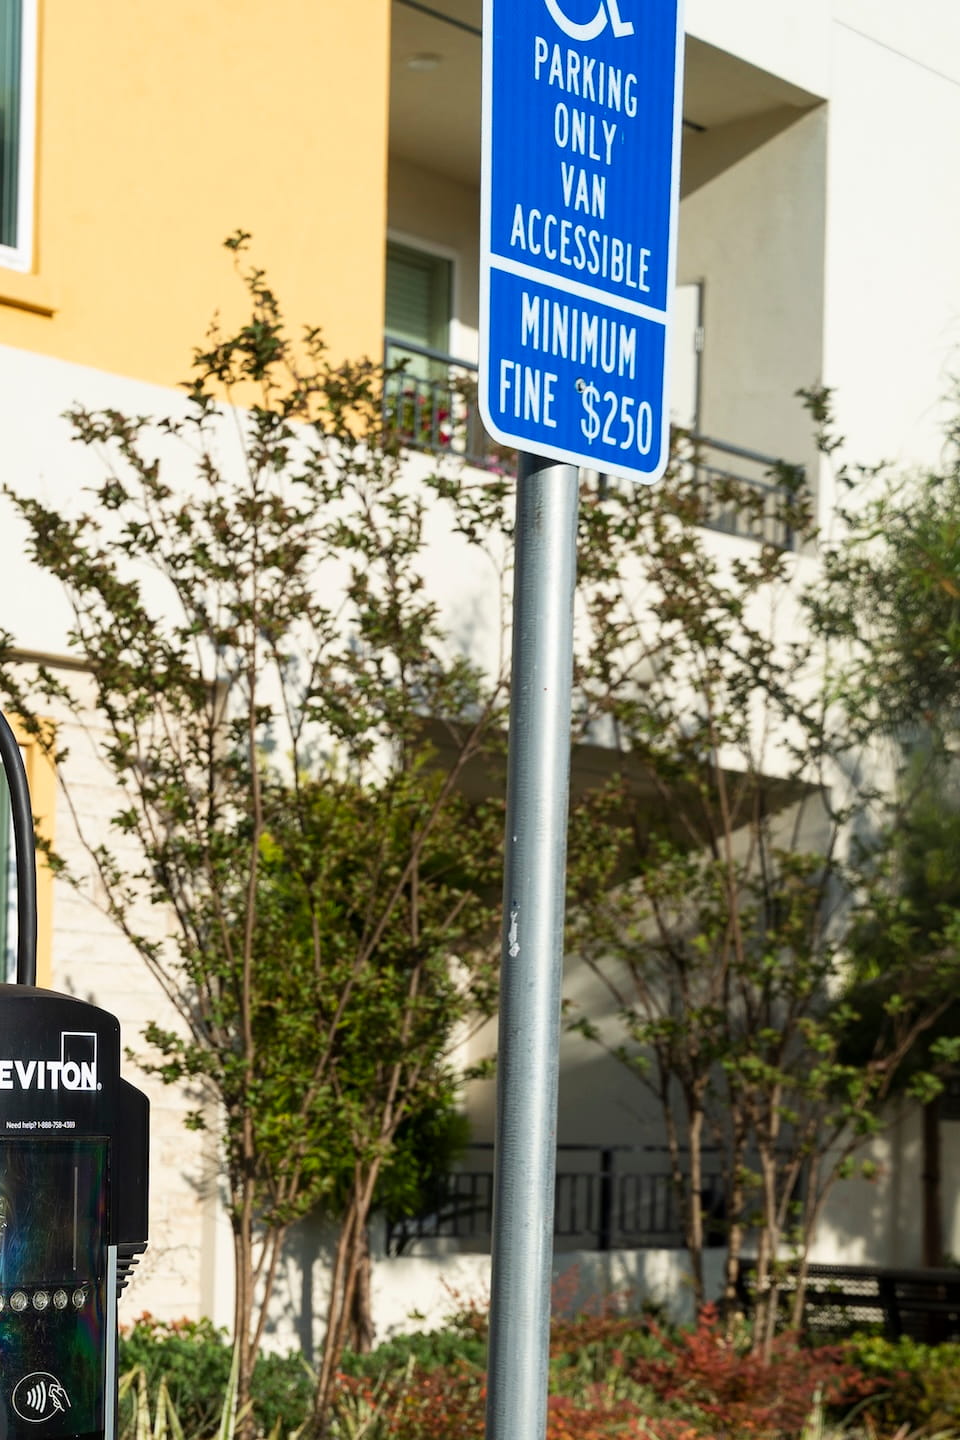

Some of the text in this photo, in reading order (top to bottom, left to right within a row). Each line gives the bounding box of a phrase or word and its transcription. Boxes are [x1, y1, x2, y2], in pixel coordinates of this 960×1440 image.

[534, 36, 637, 118] PARKING
[554, 103, 617, 165] ONLY
[560, 161, 606, 220] VAN
[510, 203, 651, 293] ACCESSIBLE
[521, 291, 636, 380] MINIMUM
[499, 359, 653, 456] FINE $250
[6, 1121, 21, 1129] Need
